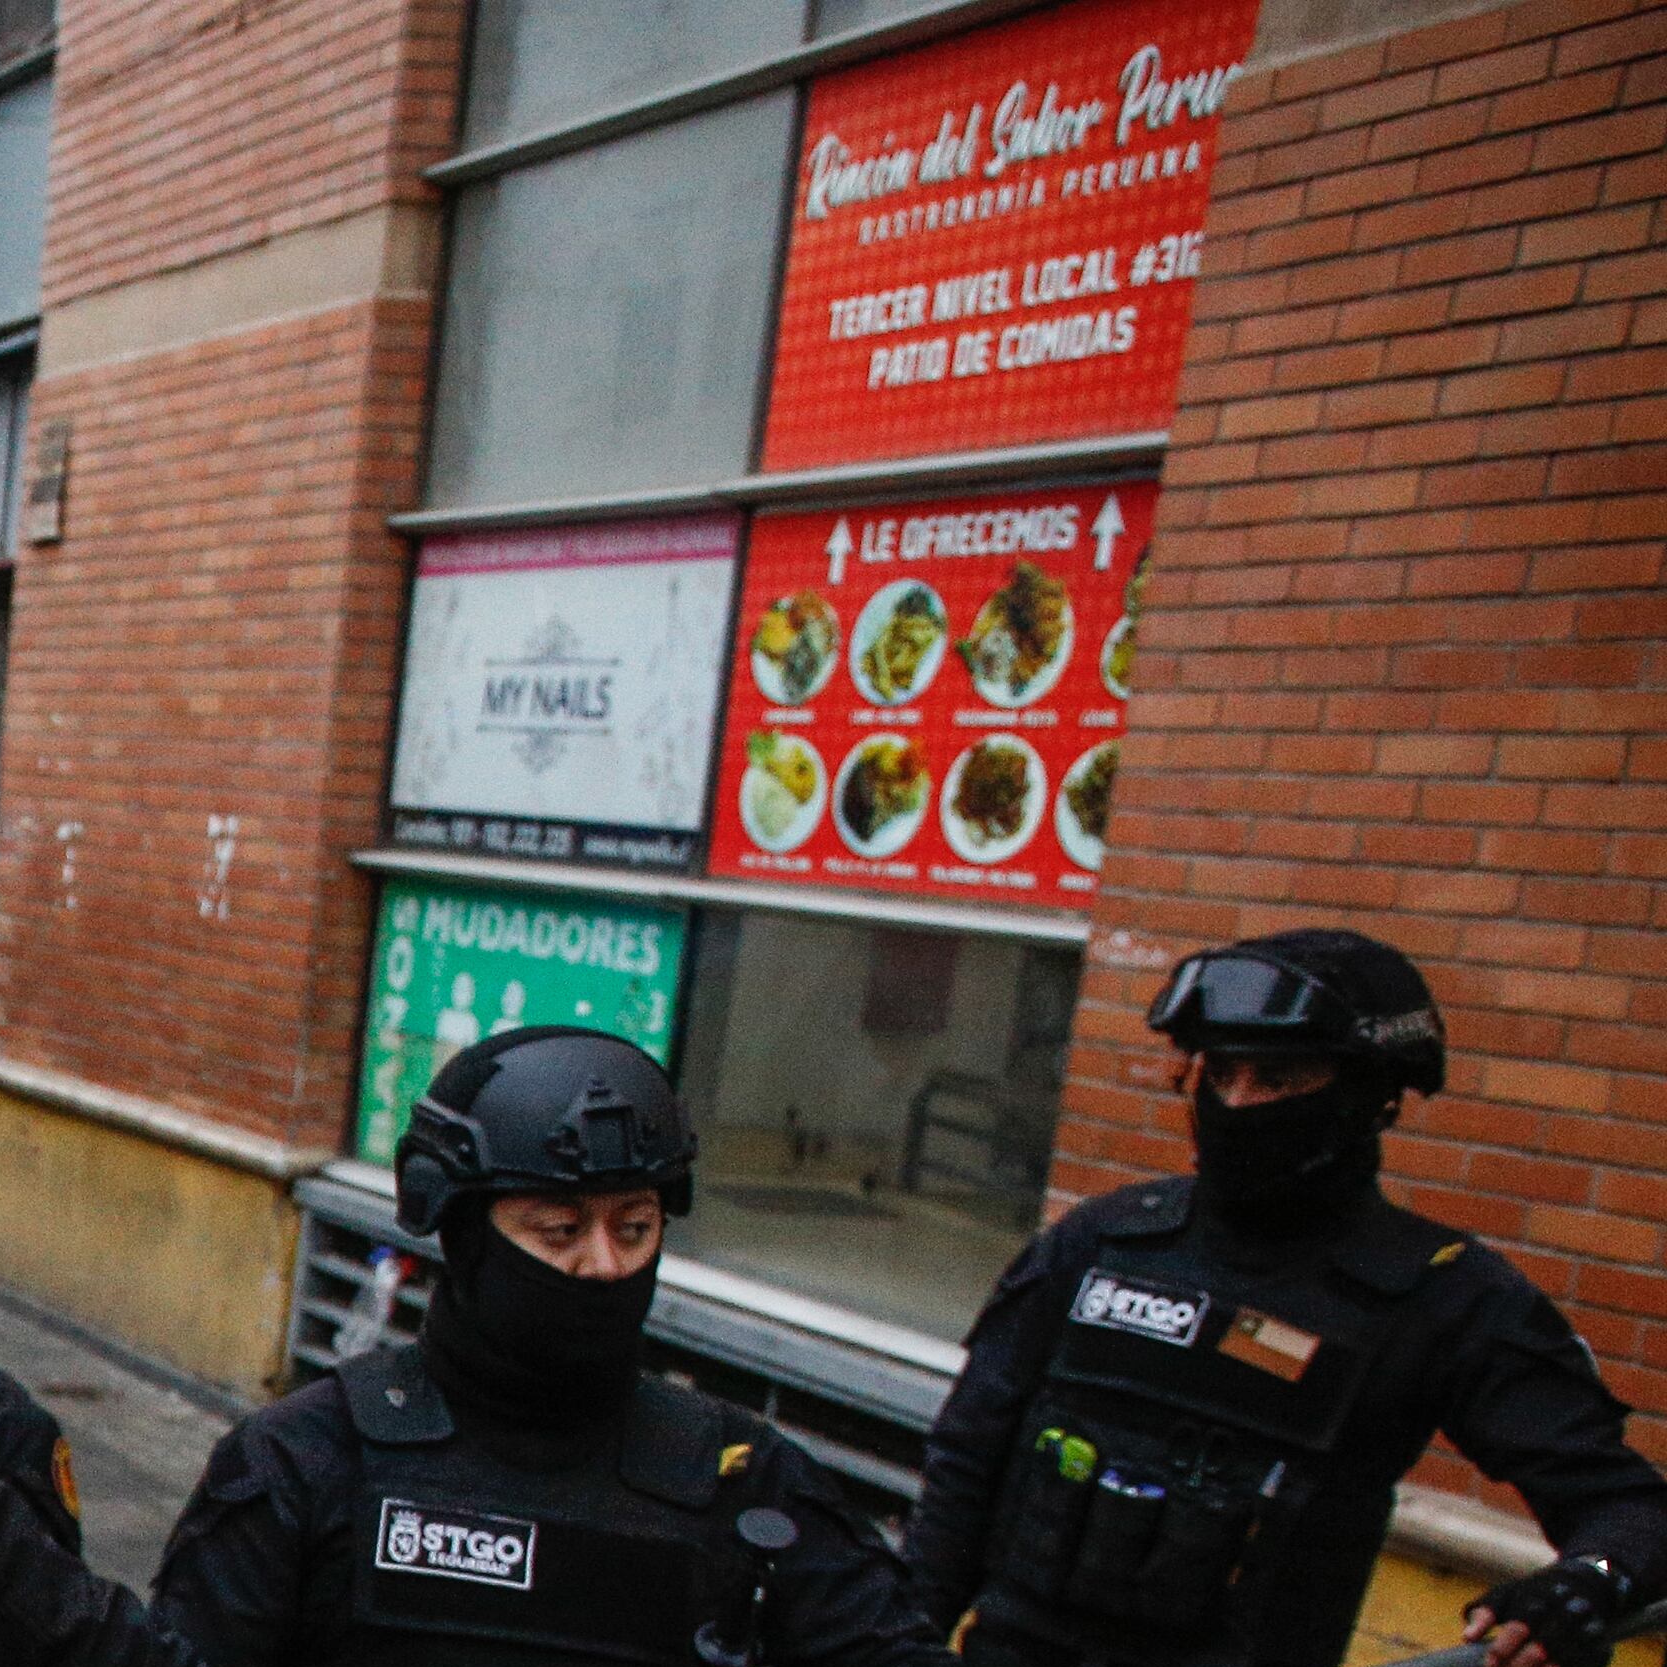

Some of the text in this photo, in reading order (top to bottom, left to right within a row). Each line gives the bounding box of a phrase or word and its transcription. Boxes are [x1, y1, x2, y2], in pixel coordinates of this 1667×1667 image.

[918, 102, 983, 183] del
[984, 79, 1105, 178] Sabor
[1061, 140, 1202, 198] PERUANA
[828, 284, 928, 340] TERCER
[931, 268, 1012, 322] NIVEL
[1021, 246, 1119, 306] LOCAL
[867, 304, 1140, 390] PATIO DE COMIDAS
[860, 503, 1081, 565] LE OFRECEMOS
[481, 674, 612, 721] MY NAILS
[423, 896, 664, 977] MUDADORES
[421, 1522, 525, 1566] STGO
